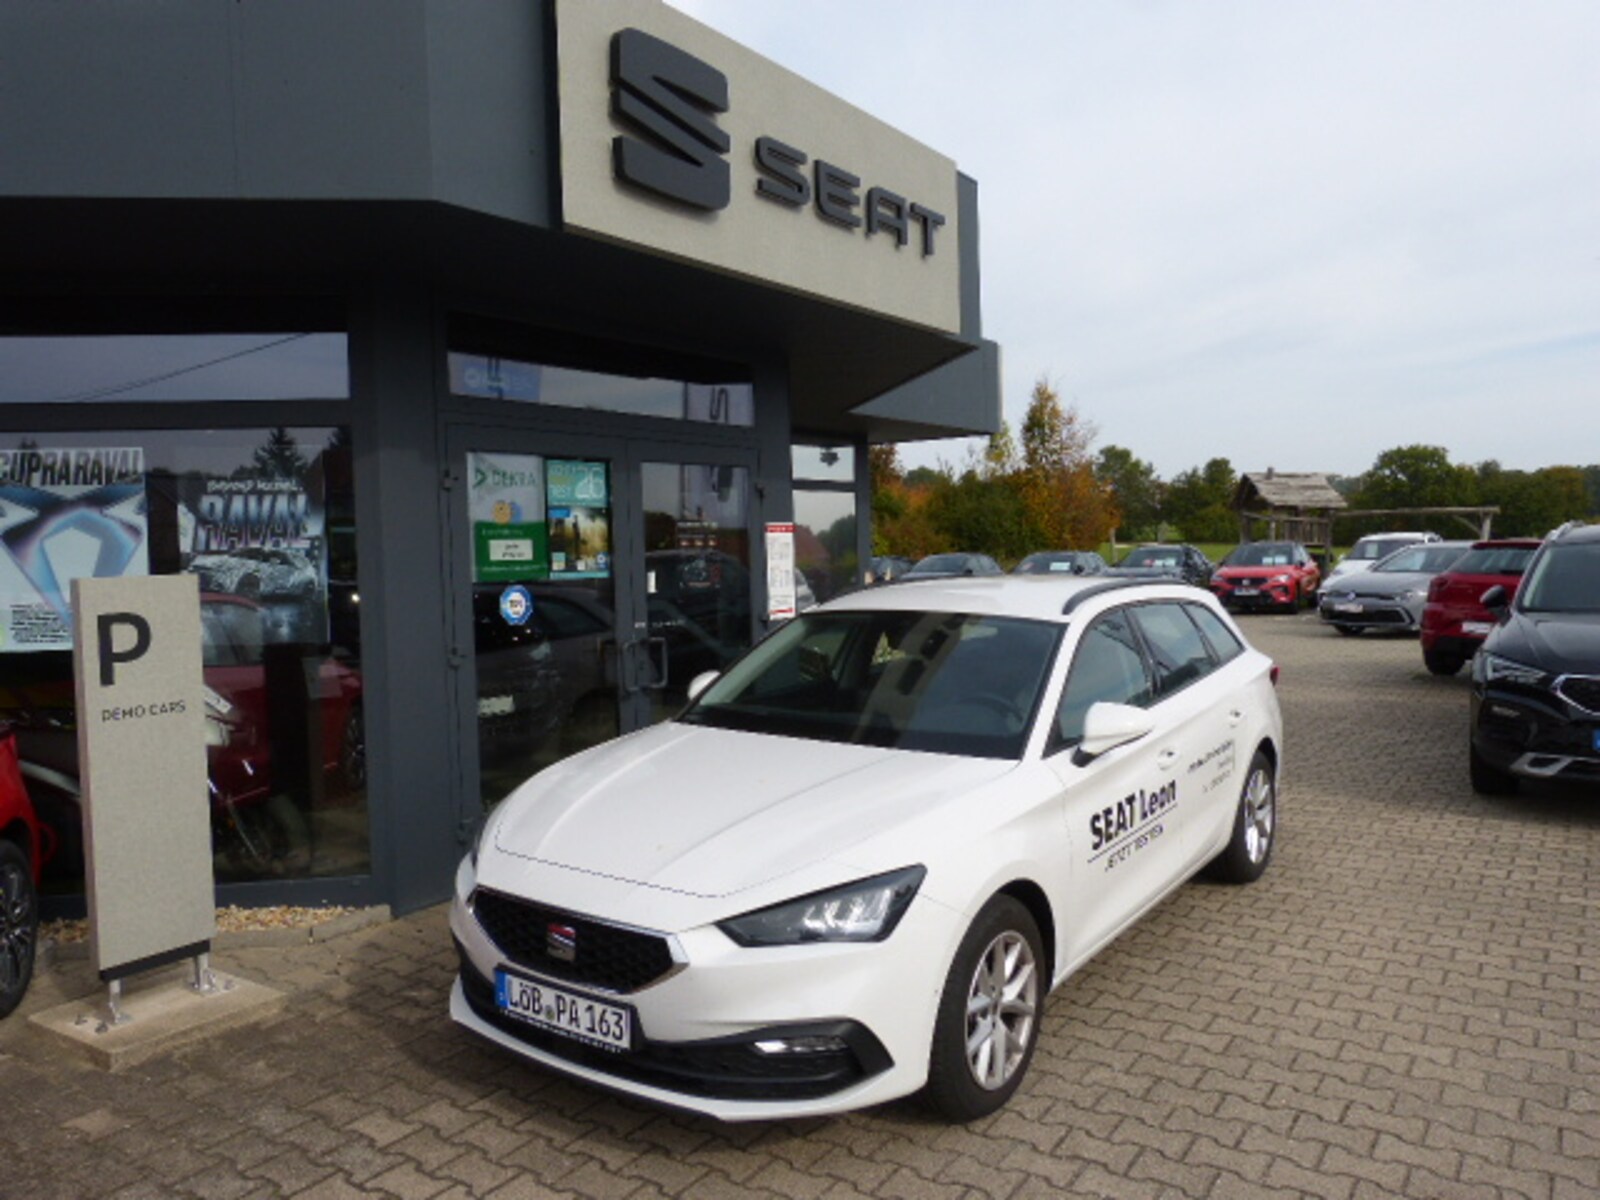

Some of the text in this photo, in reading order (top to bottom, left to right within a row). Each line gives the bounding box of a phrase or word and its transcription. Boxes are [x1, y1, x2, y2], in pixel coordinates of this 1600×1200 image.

[755, 136, 946, 256] SEAT
[97, 612, 151, 686] P
[101, 700, 186, 722] DEMO CARS
[1089, 793, 1136, 850] SEAT
[1139, 779, 1177, 820] Leon
[508, 977, 543, 1015] LÖB
[555, 993, 581, 1028] PA
[585, 1004, 624, 1041] 163
